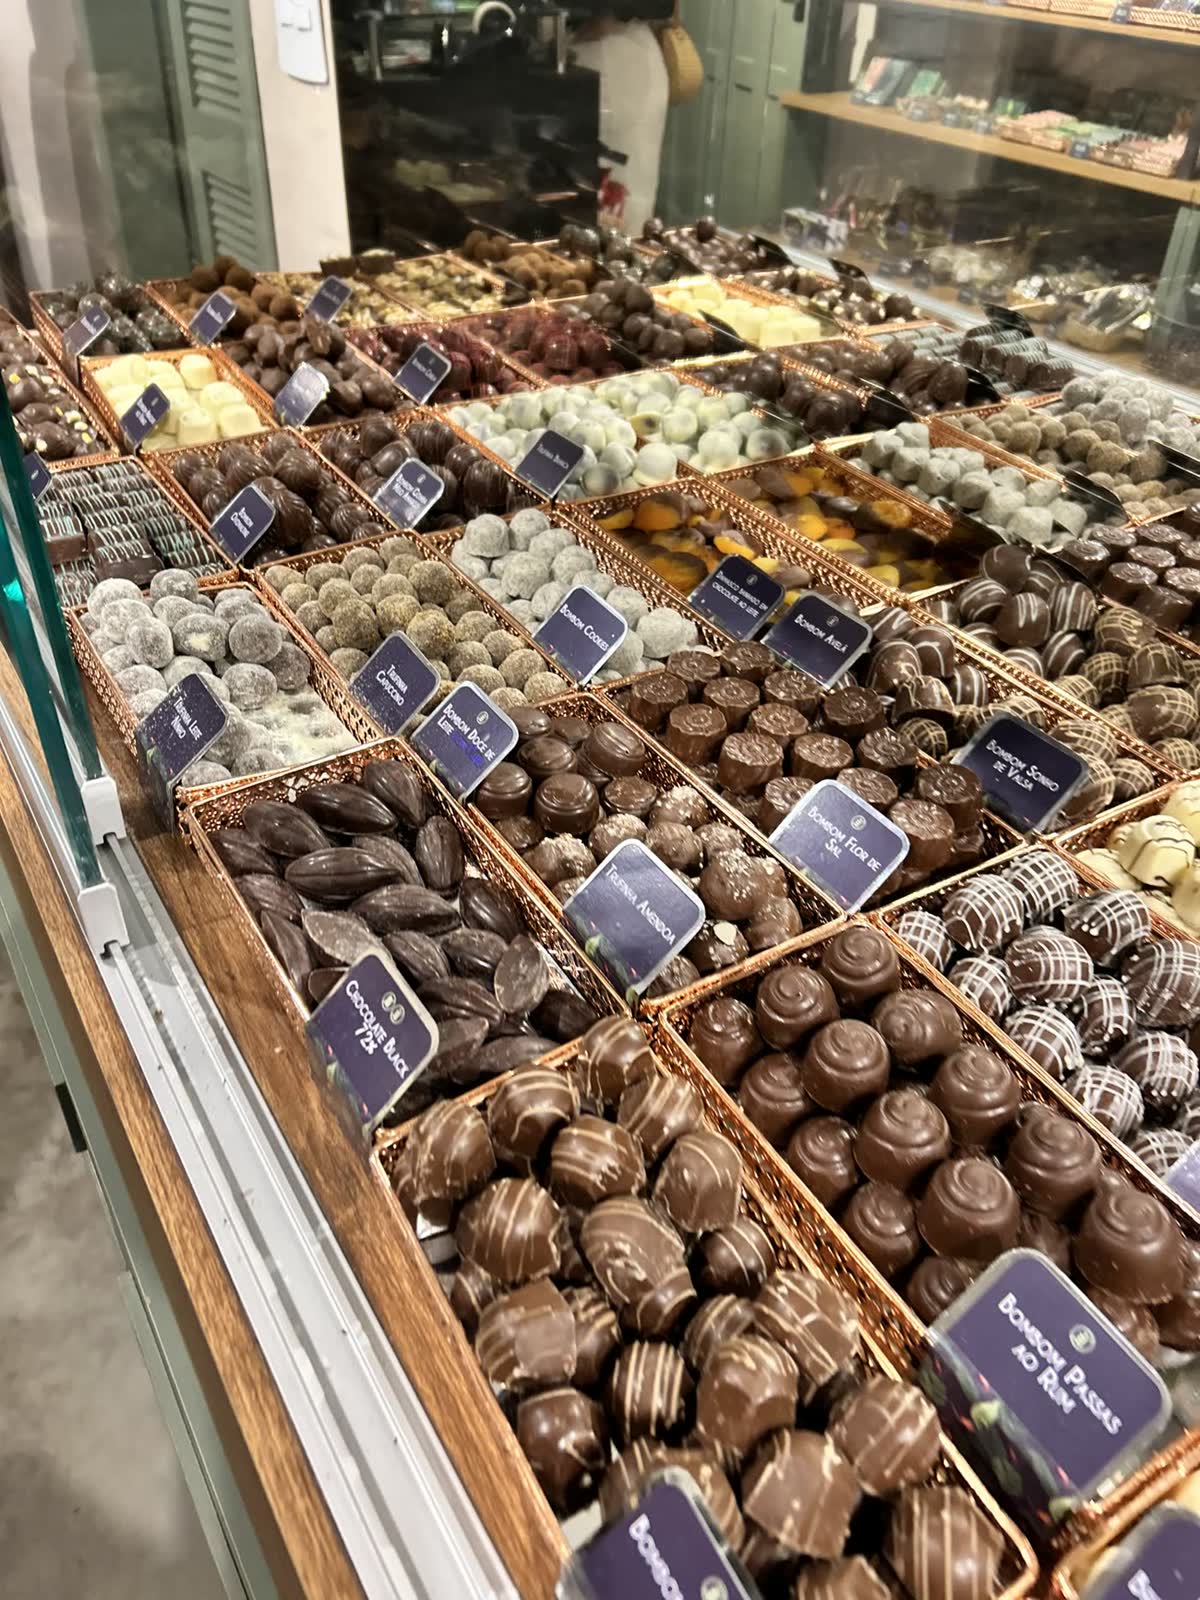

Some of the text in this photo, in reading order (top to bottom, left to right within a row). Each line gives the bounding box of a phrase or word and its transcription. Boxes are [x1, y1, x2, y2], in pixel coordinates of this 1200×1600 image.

[711, 582, 738, 604] CHOCOLATE
[715, 571, 740, 593] DAMASCO
[560, 603, 609, 651] BOMBOM COOKIES
[794, 614, 826, 640] BOMBOM
[376, 670, 404, 706] CAPUCCINO
[387, 664, 408, 694] TRUFINHA
[188, 719, 203, 740] LEITE
[437, 714, 454, 736] LEITE
[443, 703, 496, 762] BOMBOM DOCE DE
[985, 739, 1059, 792] BOMBOM SONHO
[993, 760, 1034, 791] DE VALSA
[807, 806, 882, 873] BOMBOM FLOR DE
[824, 838, 843, 859] SAL
[605, 863, 638, 907] TRUFINHA
[345, 980, 410, 1079] CHOCOLATE BLACK
[355, 1022, 378, 1055] 72%
[998, 1292, 1123, 1434] BOMBOM PASSAS
[1011, 1344, 1077, 1414] AO RUM
